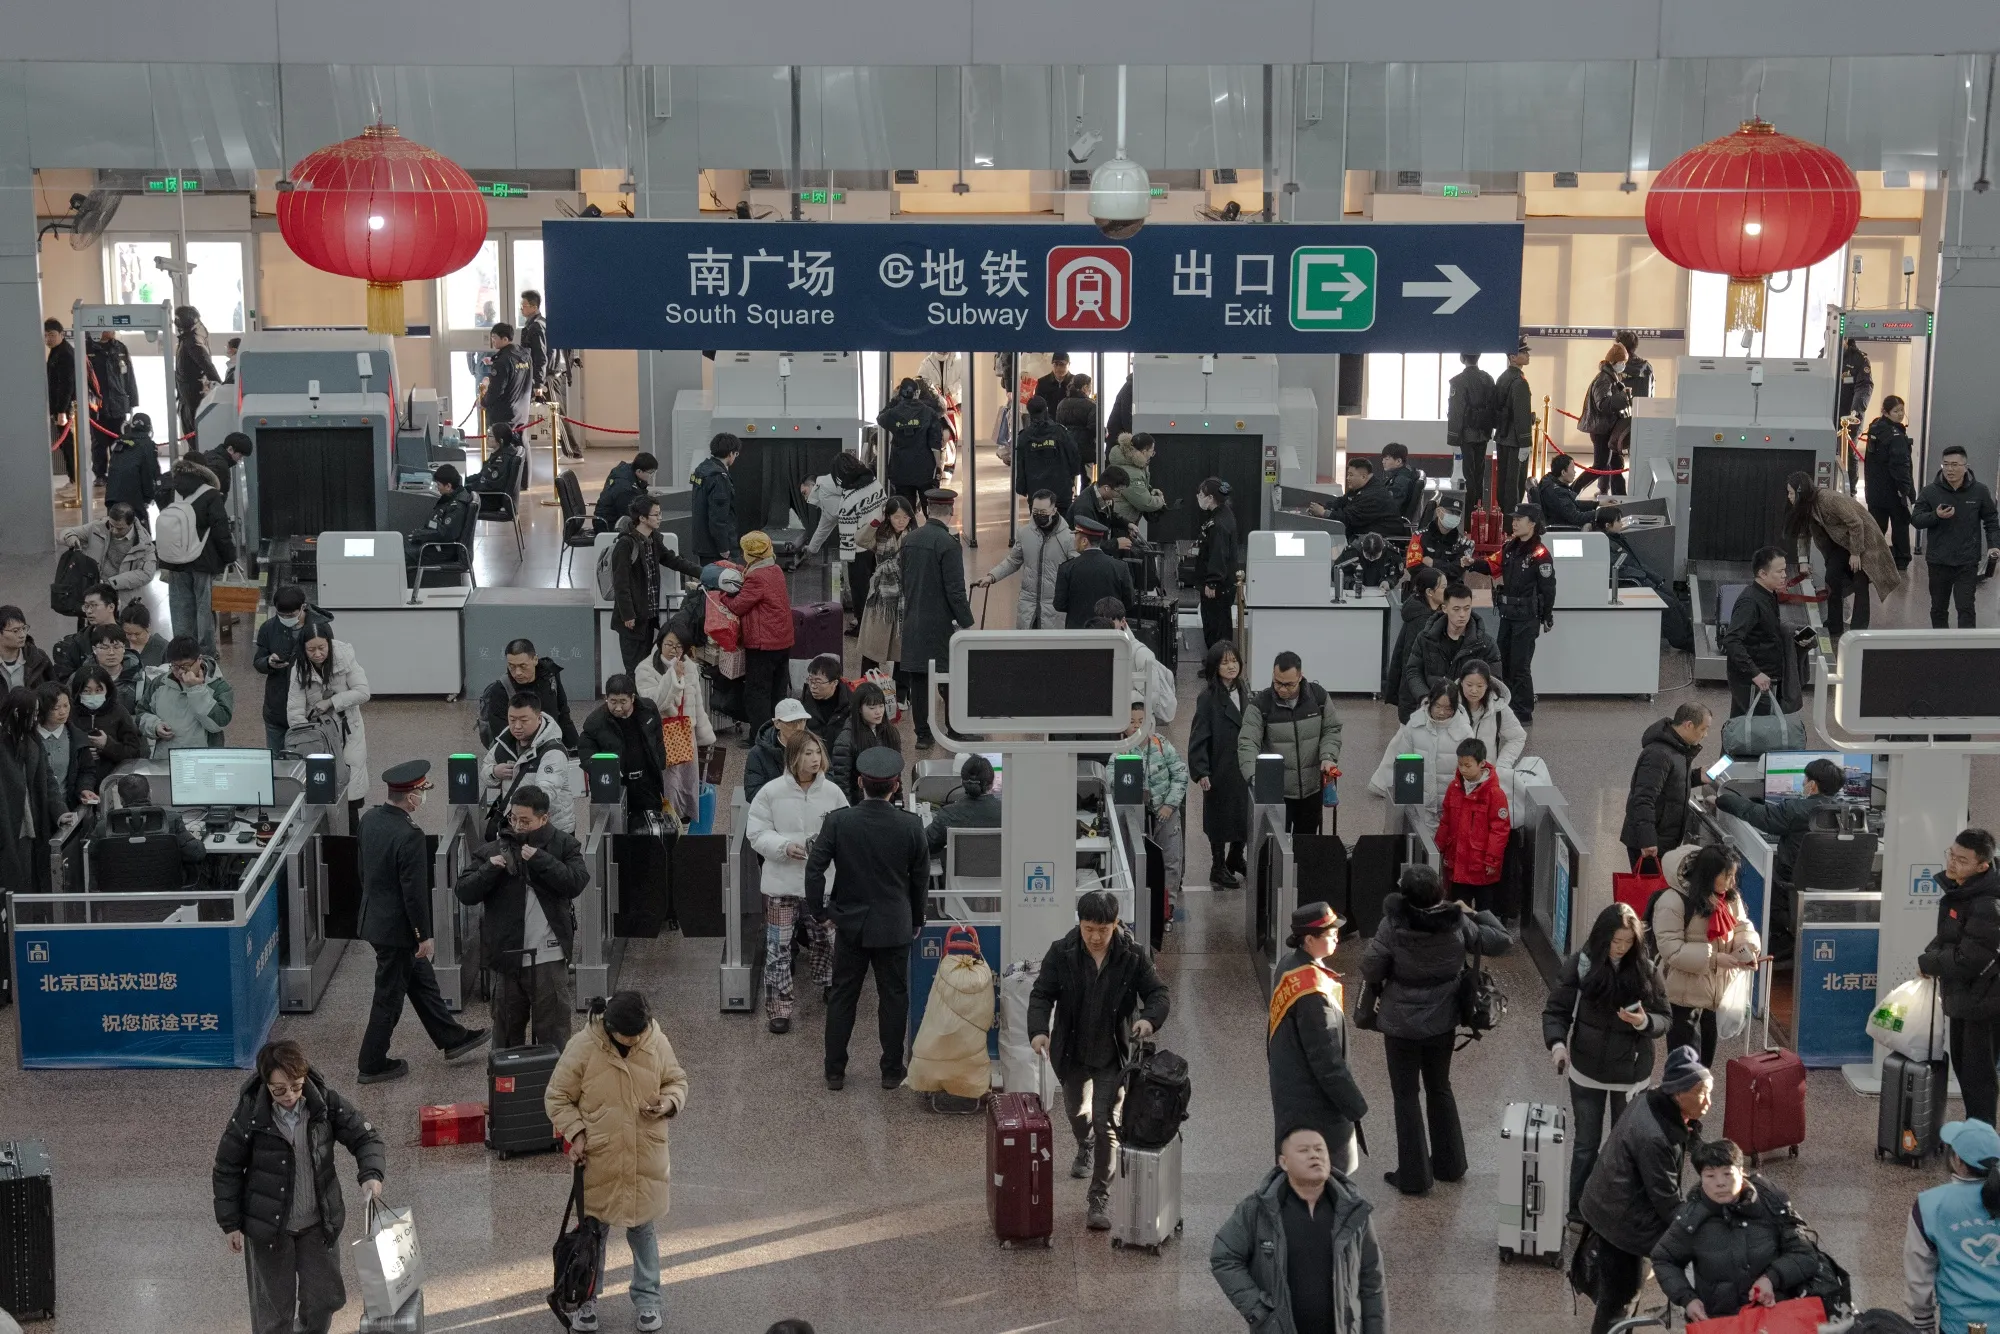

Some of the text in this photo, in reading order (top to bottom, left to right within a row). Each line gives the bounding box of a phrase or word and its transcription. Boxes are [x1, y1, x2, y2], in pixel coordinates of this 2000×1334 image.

[183, 181, 196, 189] EXIT
[687, 247, 835, 297] 南广场
[920, 248, 1030, 298] 地铁
[1173, 249, 1275, 298] 出口
[665, 303, 835, 329] South Square
[927, 302, 1029, 330] Subway
[1225, 303, 1272, 325] Exit
[313, 772, 326, 783] 40
[458, 773, 467, 785] 41
[601, 773, 610, 785] 42
[1123, 773, 1132, 785] 43
[1405, 773, 1415, 784] 45
[39, 972, 178, 993] 北京西站欢迎您
[101, 1012, 220, 1033] 祝您旅途平安
